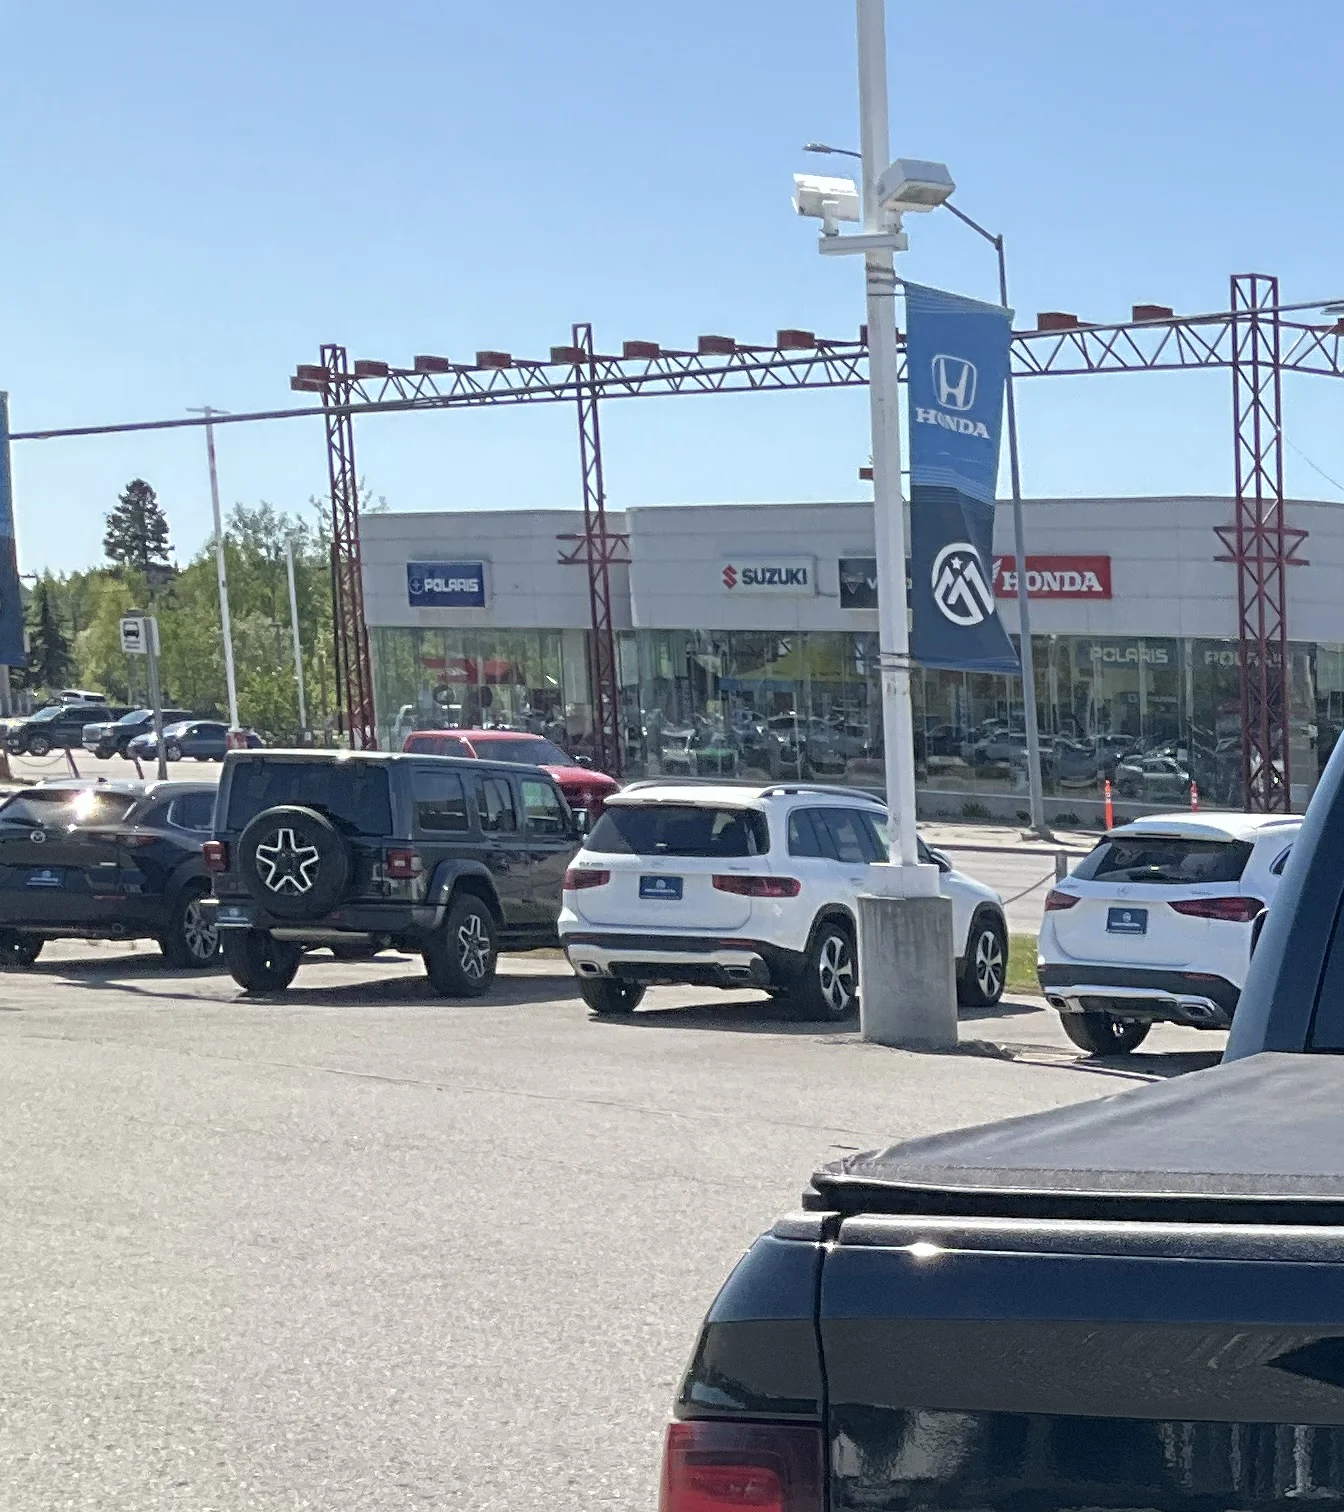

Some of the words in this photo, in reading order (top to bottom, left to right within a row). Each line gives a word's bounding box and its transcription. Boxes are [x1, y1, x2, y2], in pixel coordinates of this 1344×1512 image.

[916, 407, 991, 440] HONDA
[423, 578, 479, 593] POLARIS
[742, 567, 808, 586] SUZUKI
[1002, 570, 1103, 592] HONDA
[1089, 646, 1169, 664] POLARIS
